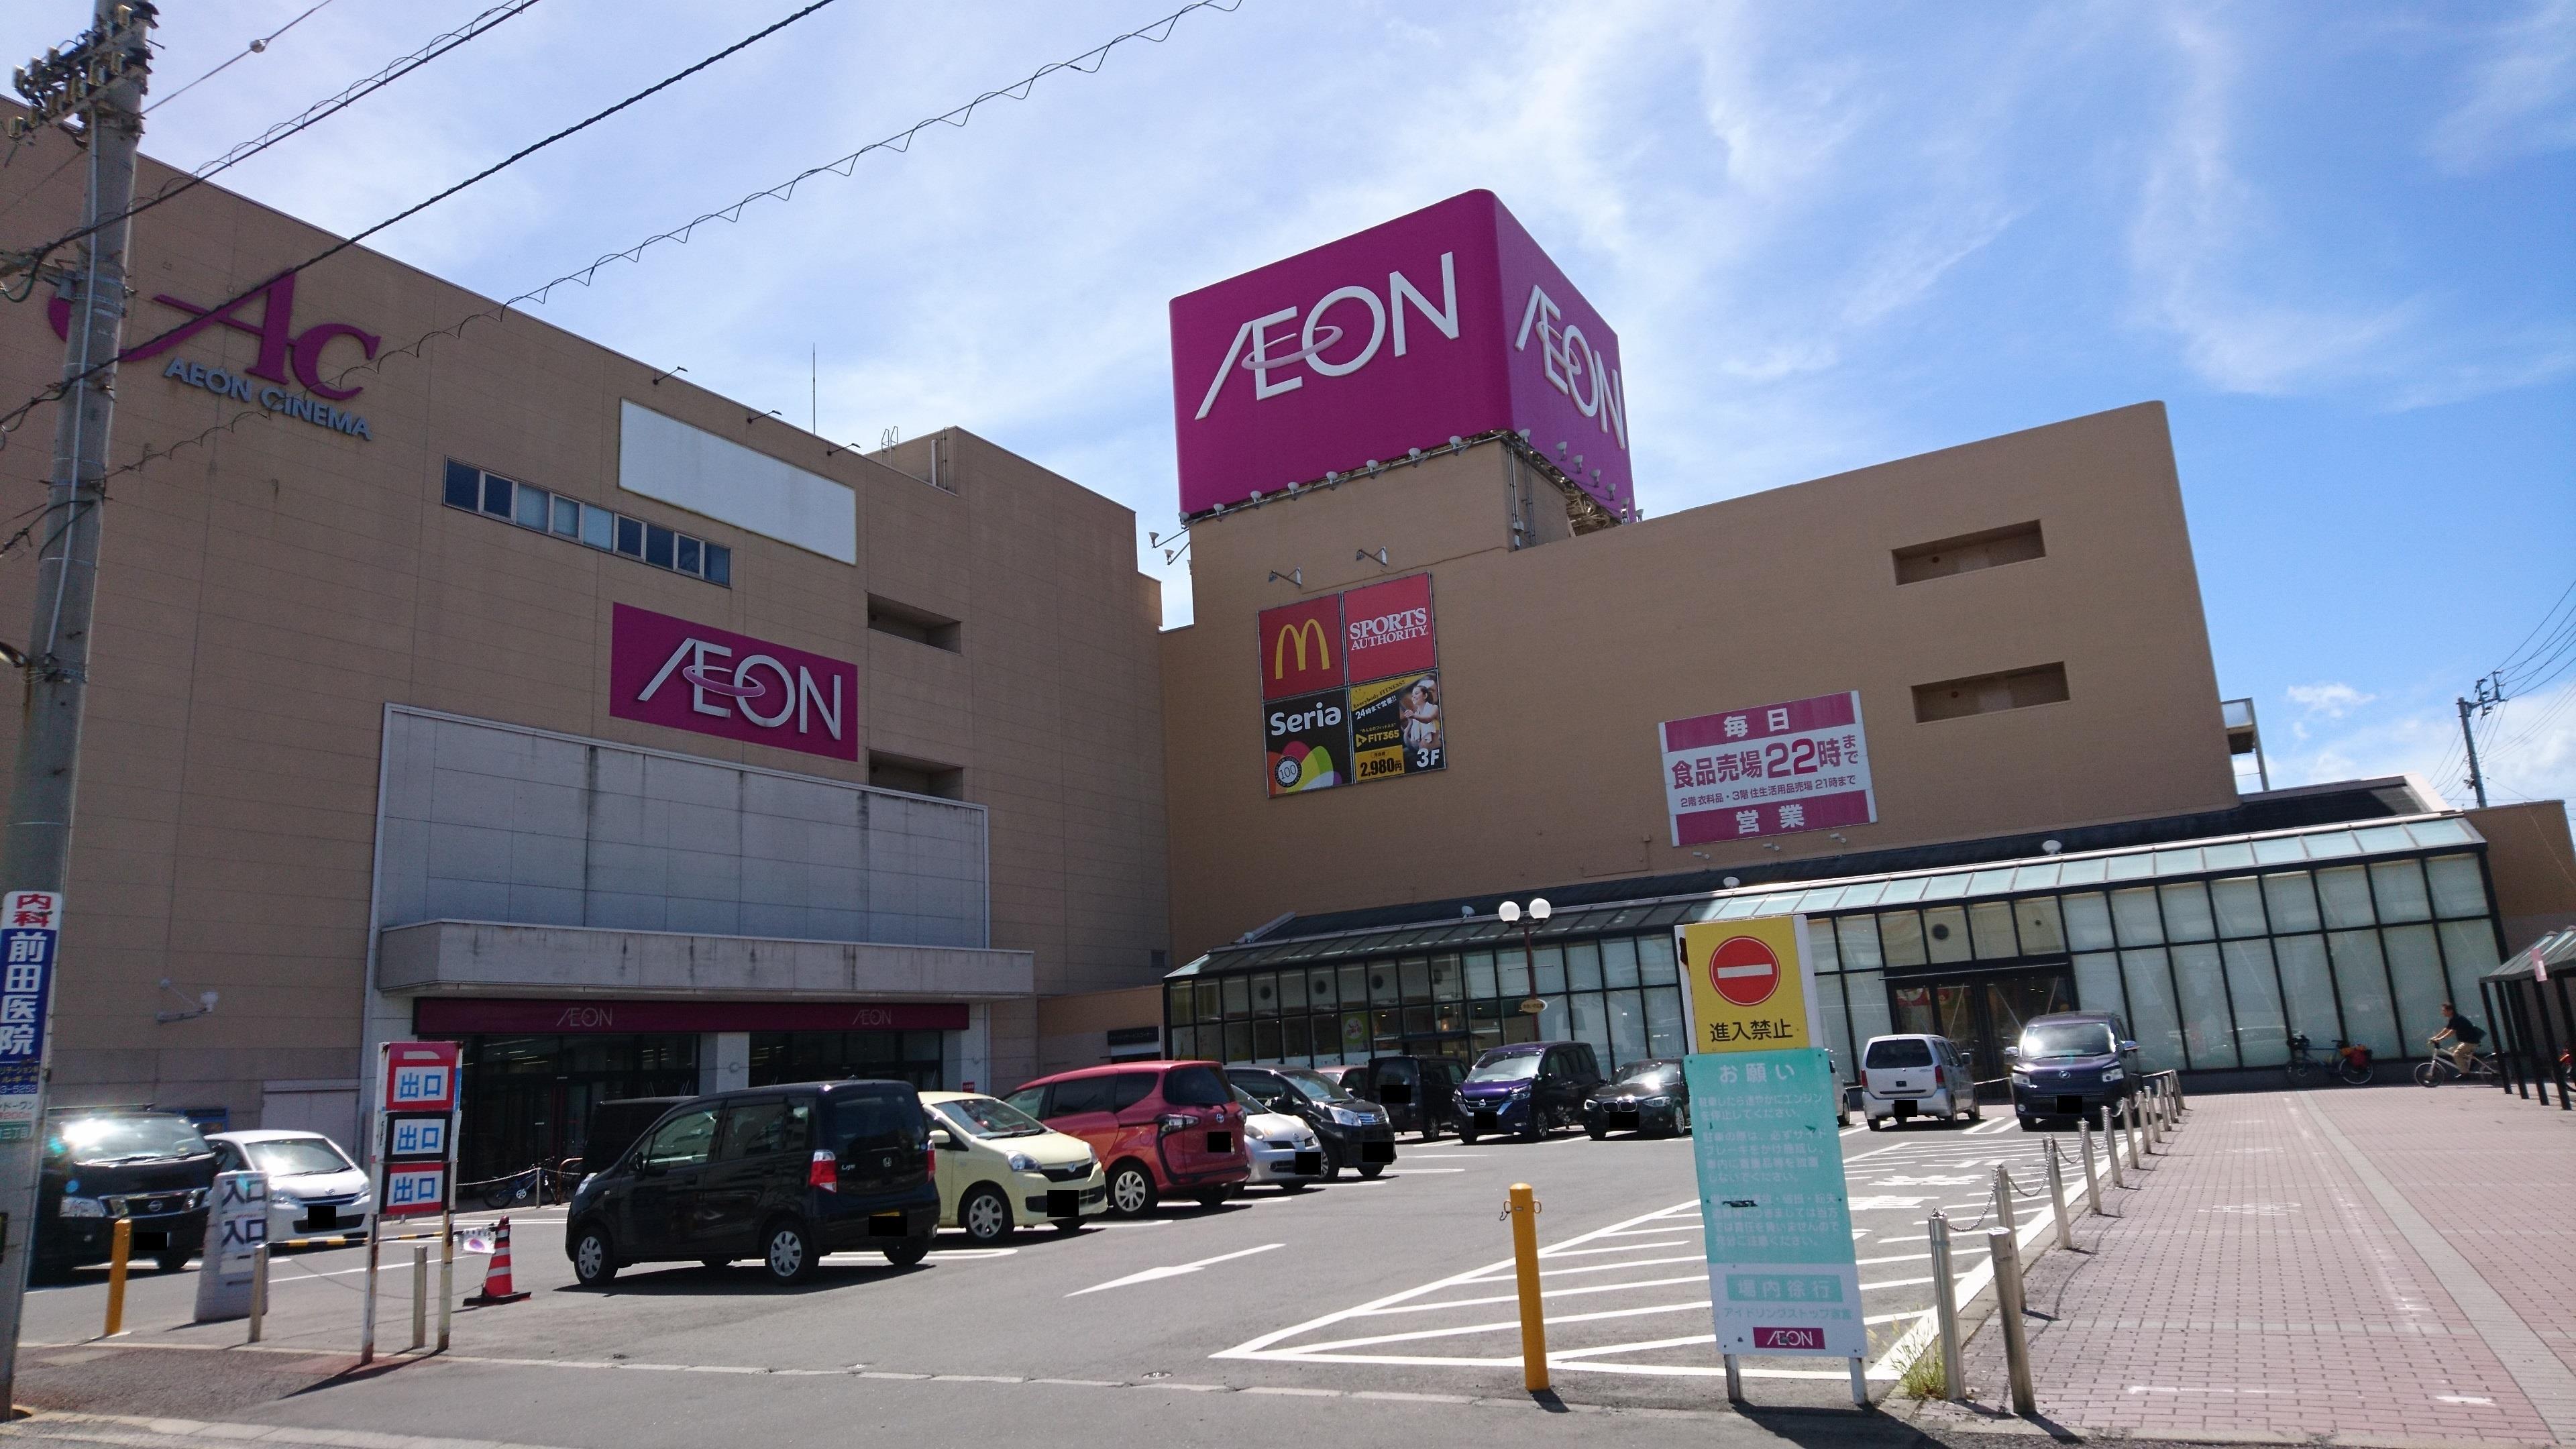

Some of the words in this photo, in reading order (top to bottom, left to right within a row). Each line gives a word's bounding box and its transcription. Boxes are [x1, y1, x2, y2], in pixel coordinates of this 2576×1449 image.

[164, 358, 252, 402] AEON
[259, 386, 372, 440] CINEMA
[1350, 606, 1428, 641] SPORTS
[1350, 625, 1428, 651] AUTHORITY
[1353, 692, 1379, 708] Everybody
[1270, 702, 1342, 736] Seria
[1724, 708, 1790, 738] 毎日
[1368, 729, 1399, 743] FIT365
[1416, 748, 1440, 767] 3F
[1279, 765, 1296, 779] 100
[1735, 803, 1805, 834] 営業
[13, 894, 52, 927] 内科
[0, 931, 48, 1055] 前田医院
[1710, 1018, 1793, 1042] 進入禁止
[400, 1073, 442, 1098] 出口
[1719, 1062, 1796, 1084] お願い
[398, 1125, 439, 1151] 出口
[222, 1180, 266, 1207] 入口
[394, 1177, 435, 1203] 出口
[221, 1218, 266, 1247] 入口
[1738, 1280, 1830, 1299] 場内徐行
